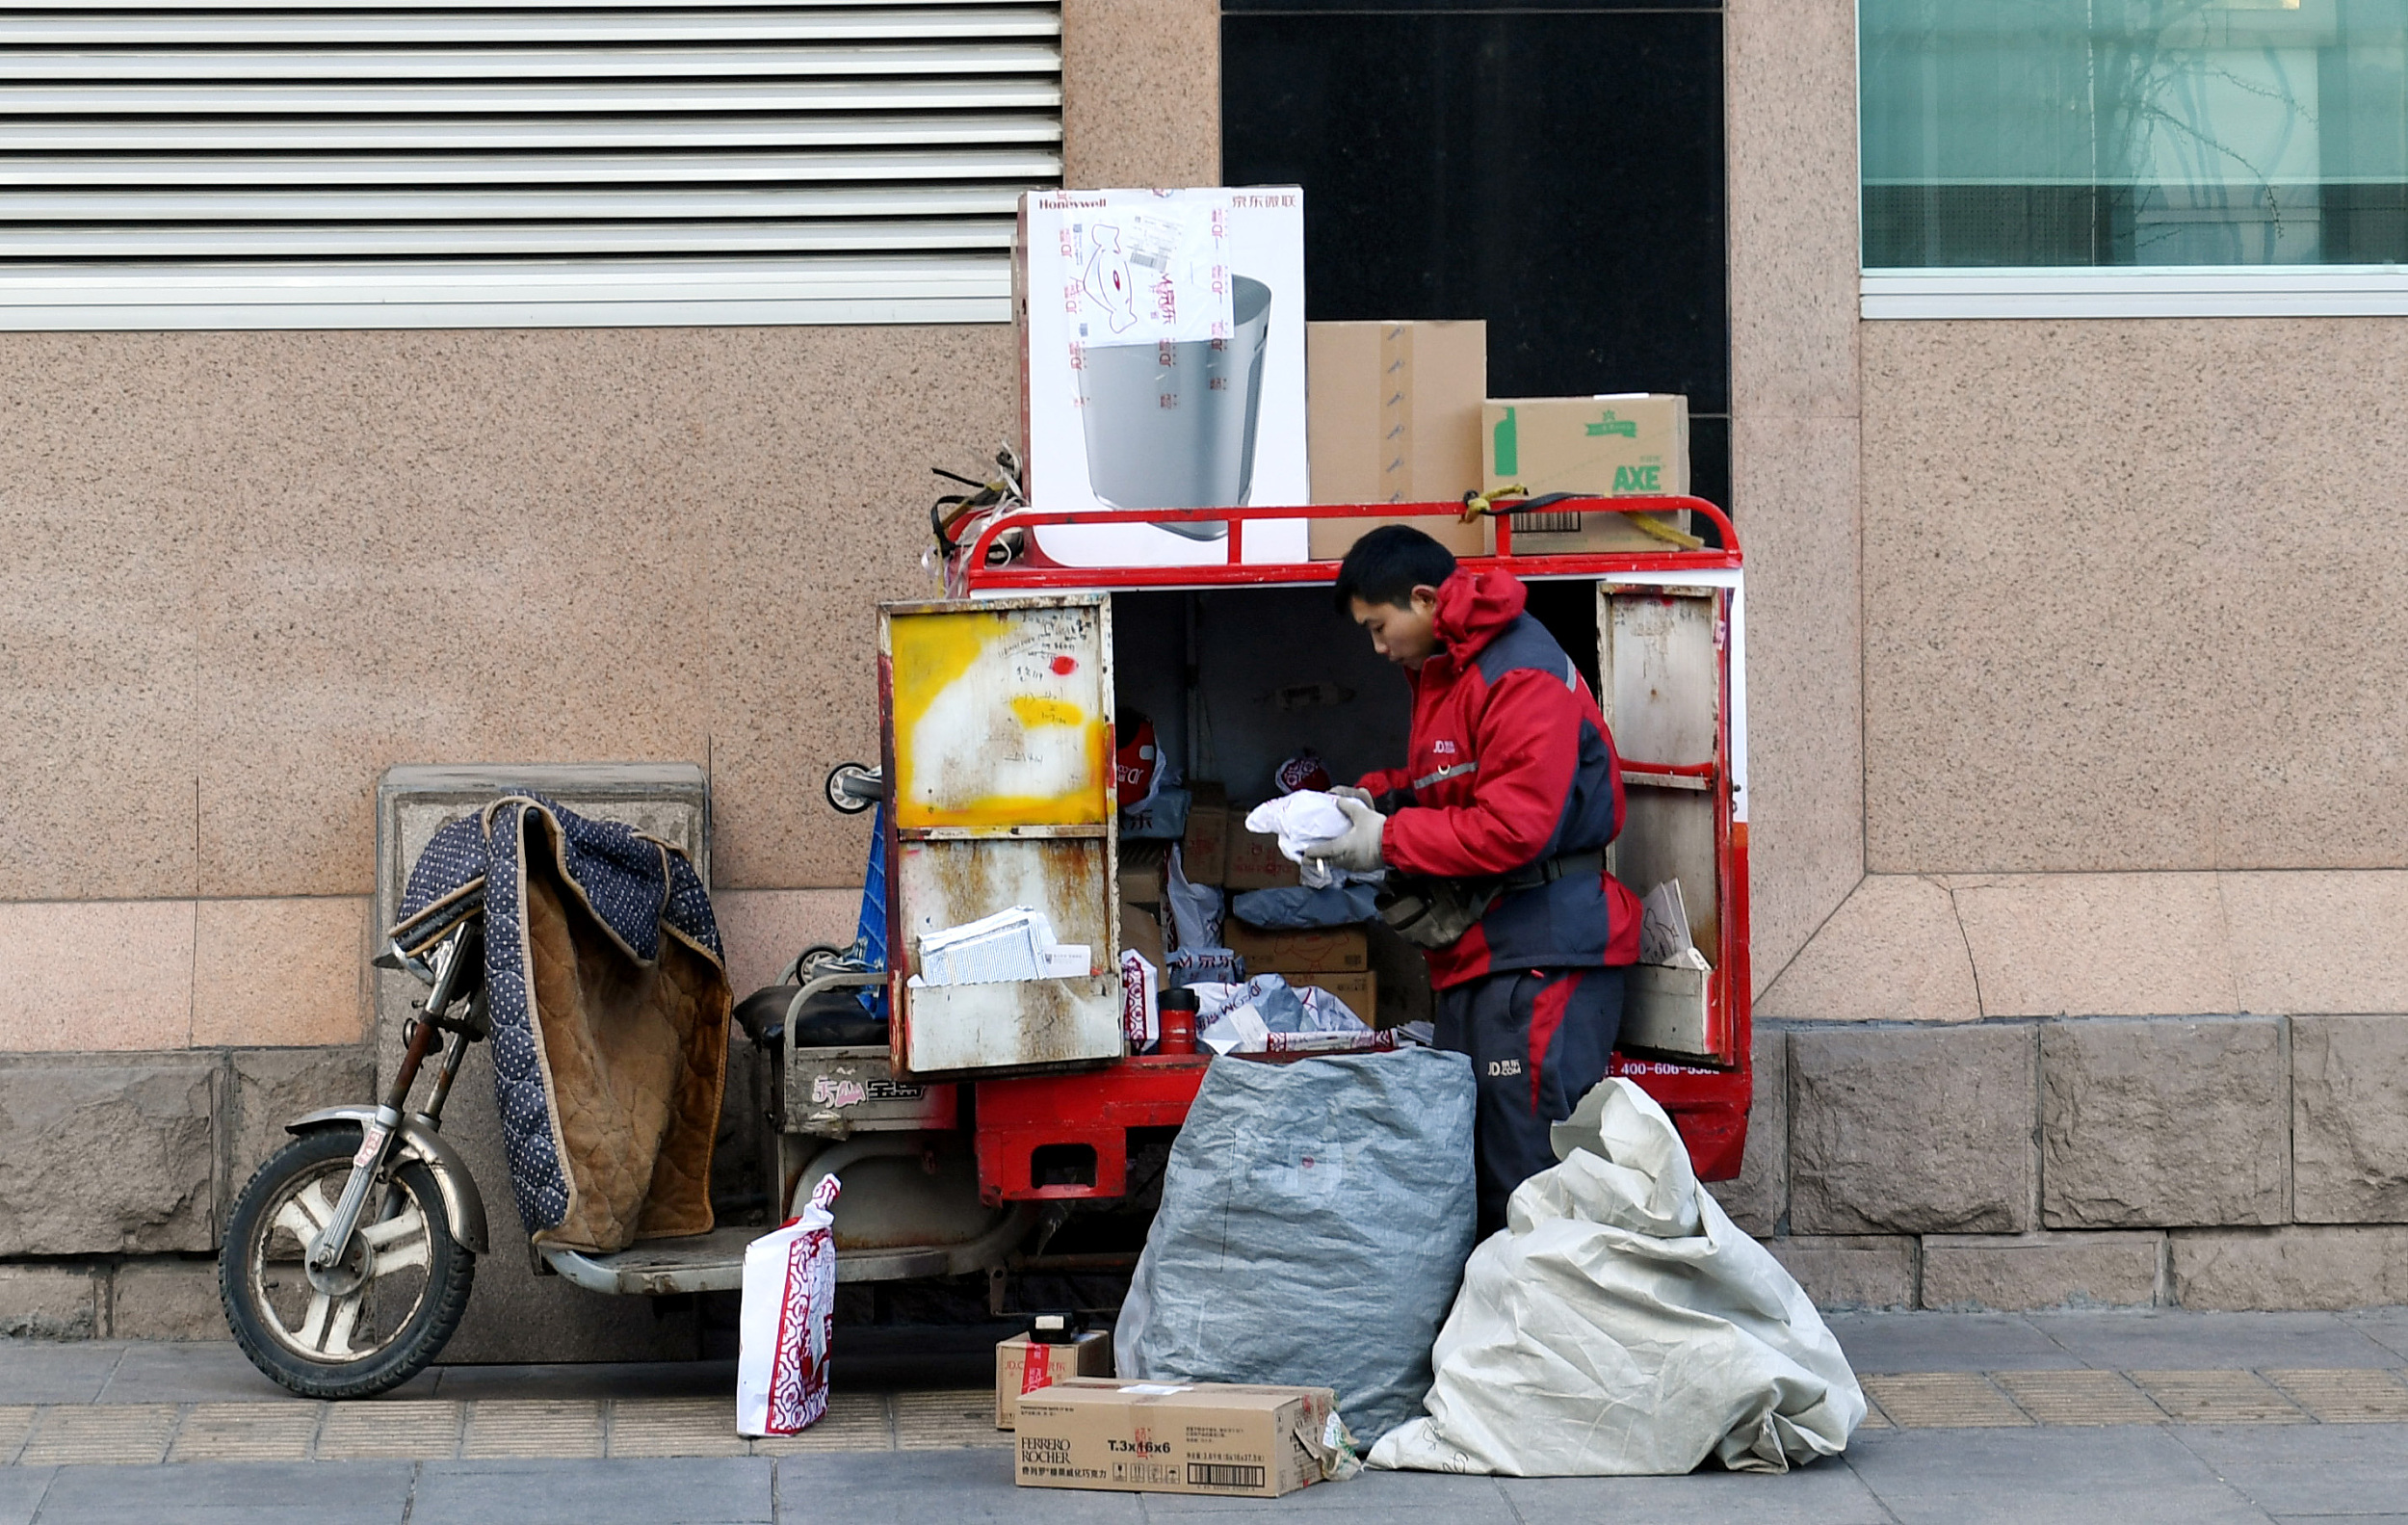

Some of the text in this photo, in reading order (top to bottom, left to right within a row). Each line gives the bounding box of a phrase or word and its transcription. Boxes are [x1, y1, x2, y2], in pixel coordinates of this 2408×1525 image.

[1039, 198, 1107, 210] Honeywell
[1232, 195, 1296, 208] 京东微联
[1612, 465, 1662, 491] AXE
[1021, 1436, 1071, 1451] FERRERO
[1022, 1450, 1071, 1464] ROCHER
